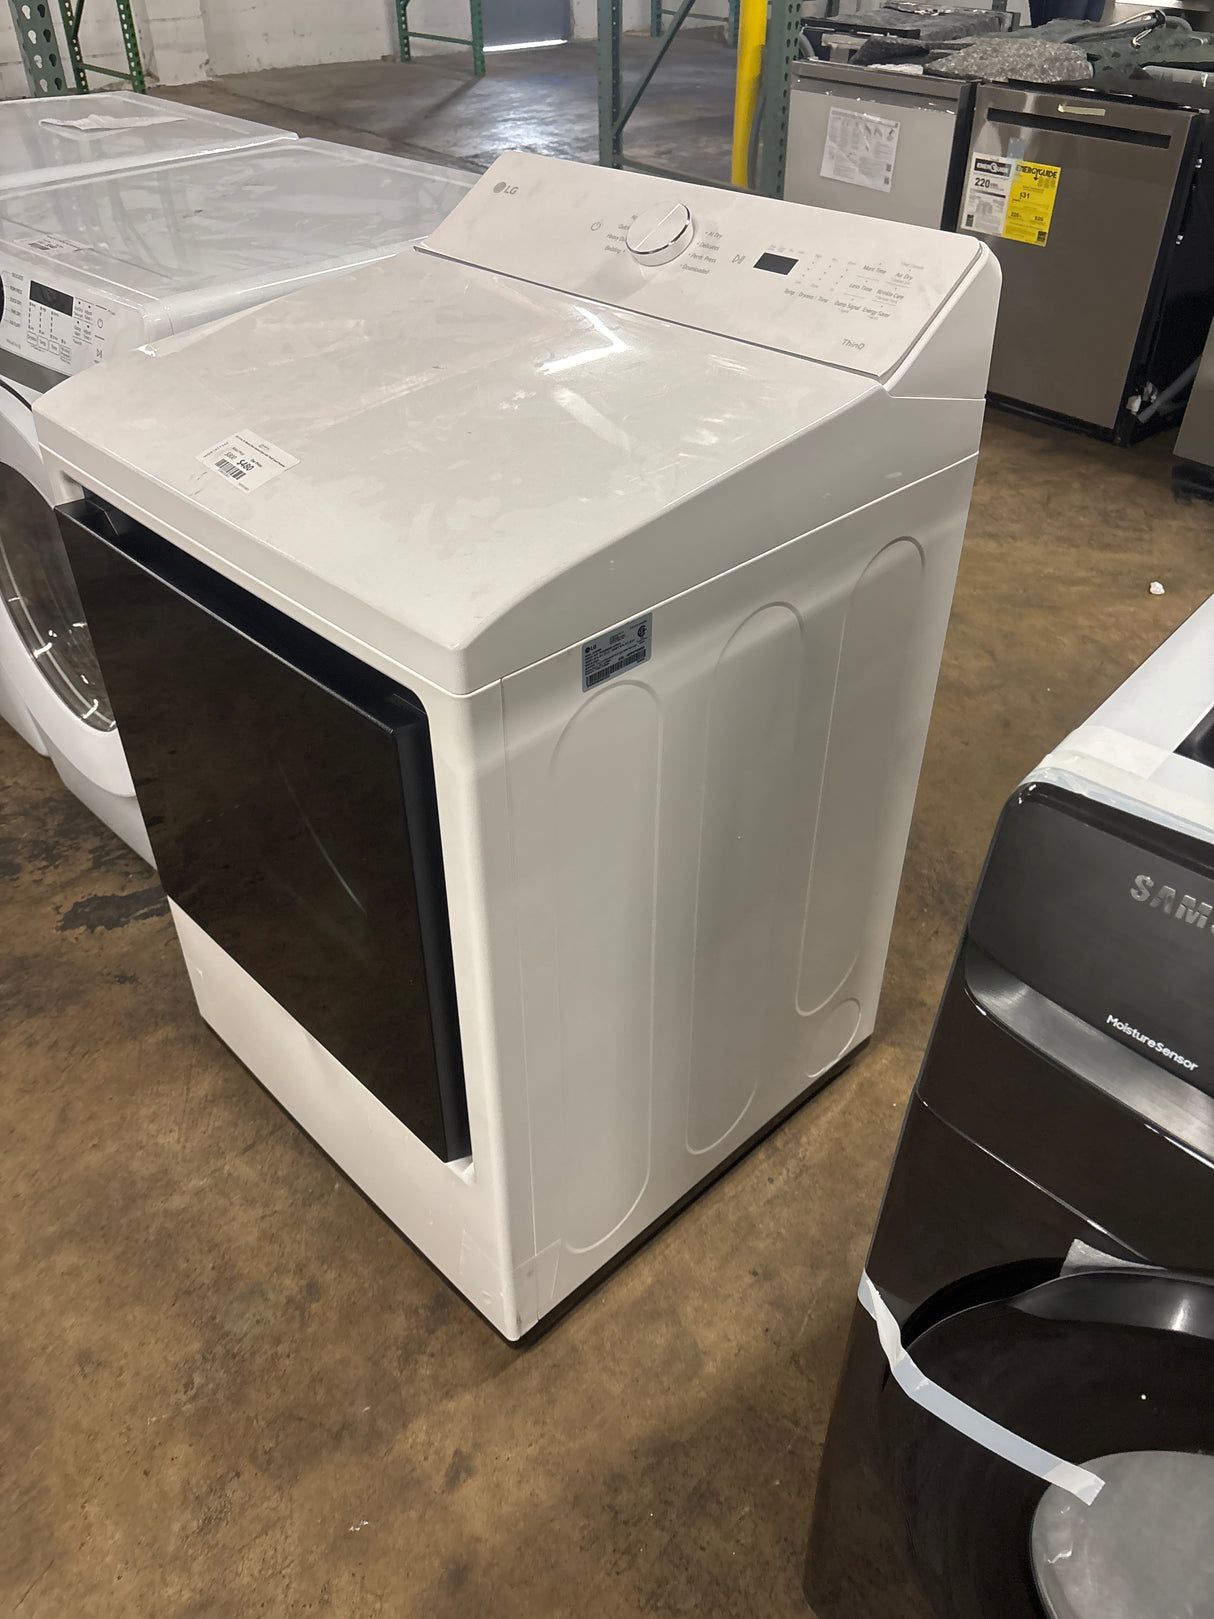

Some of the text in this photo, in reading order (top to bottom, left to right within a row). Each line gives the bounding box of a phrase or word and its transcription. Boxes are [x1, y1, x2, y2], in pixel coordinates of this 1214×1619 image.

[974, 177, 991, 188] 220
[842, 338, 865, 350] ThinQ
[236, 459, 255, 471] $480
[1130, 874, 1214, 935] SAM
[1106, 1014, 1199, 1072] MoistureSensor
